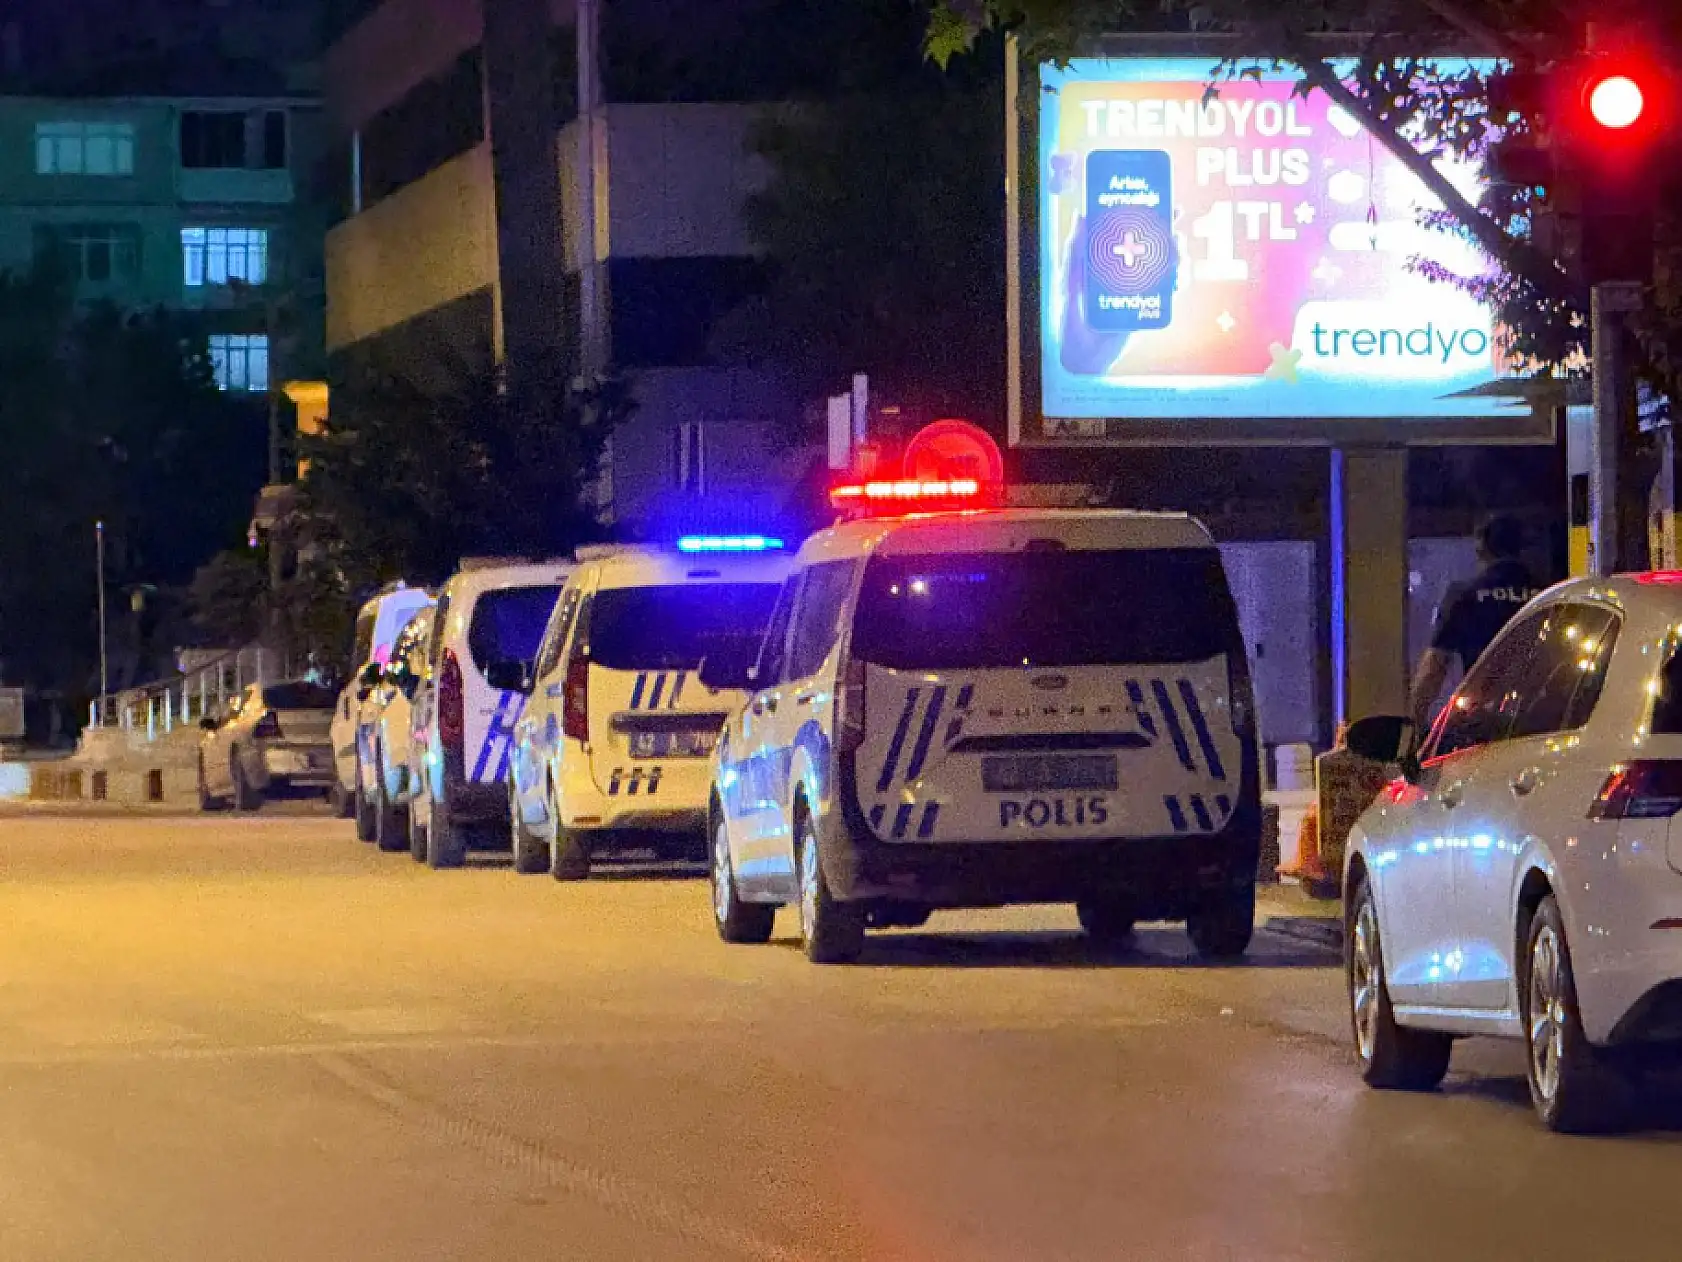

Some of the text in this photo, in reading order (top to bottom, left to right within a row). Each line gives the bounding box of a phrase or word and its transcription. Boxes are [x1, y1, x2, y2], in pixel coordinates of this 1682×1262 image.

[1079, 100, 1312, 137] TRENDYOL
[1197, 148, 1310, 186] PLUS
[1311, 321, 1488, 364] trendyo
